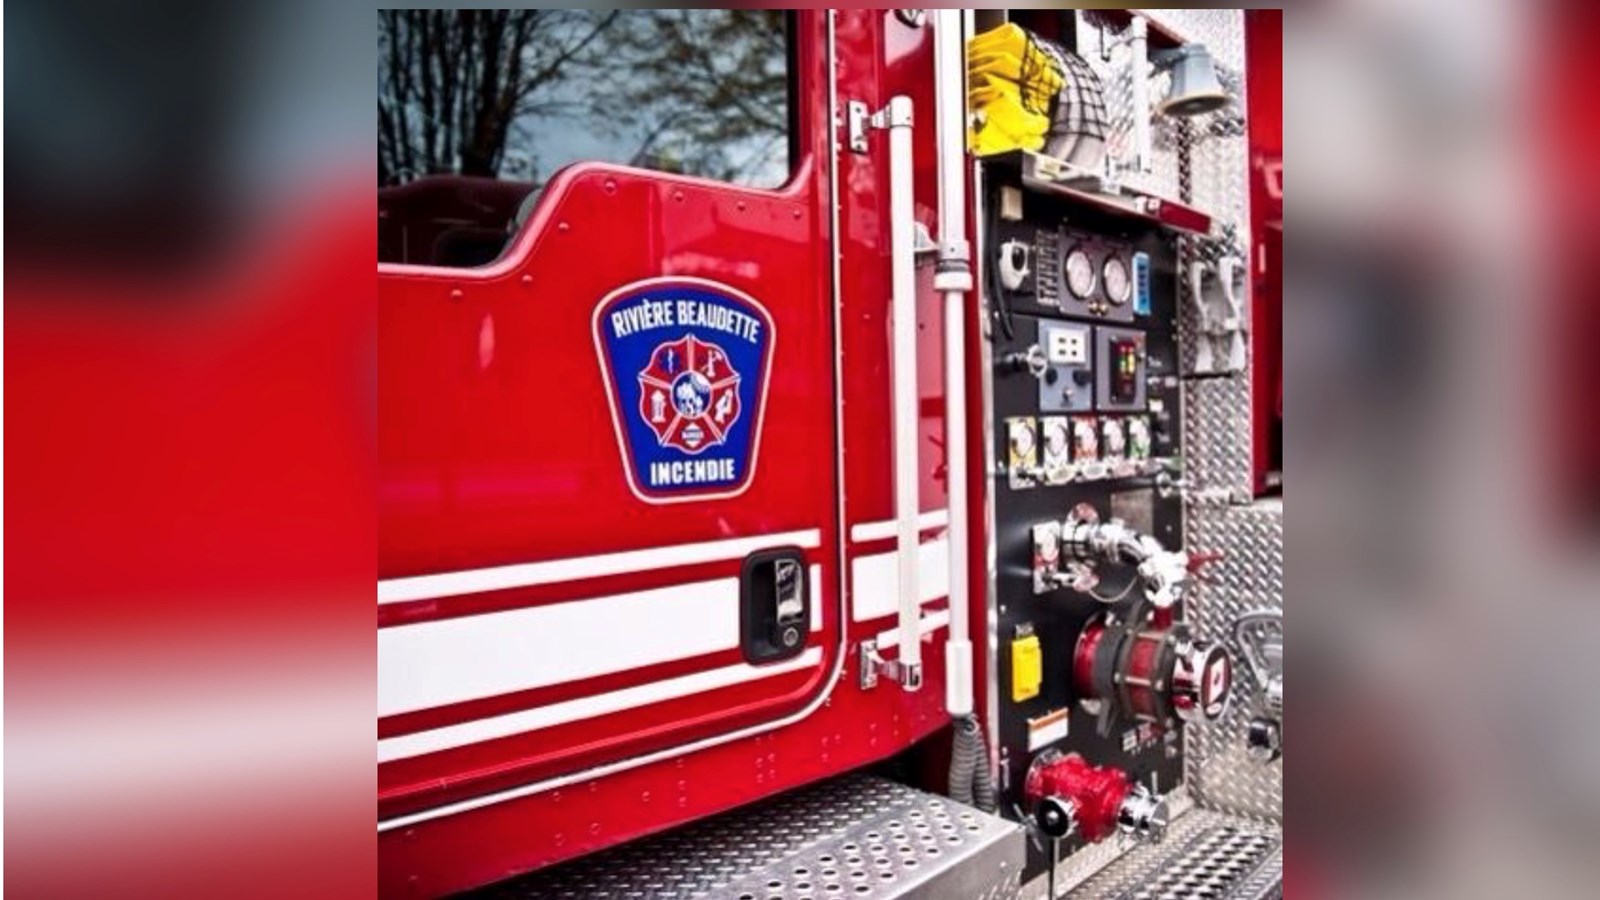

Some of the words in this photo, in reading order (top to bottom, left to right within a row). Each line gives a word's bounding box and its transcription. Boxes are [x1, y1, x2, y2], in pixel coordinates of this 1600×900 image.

[612, 298, 673, 338] RIVIÈRE
[678, 300, 760, 343] BEAUDETTE
[651, 459, 734, 485] INCENDIE
